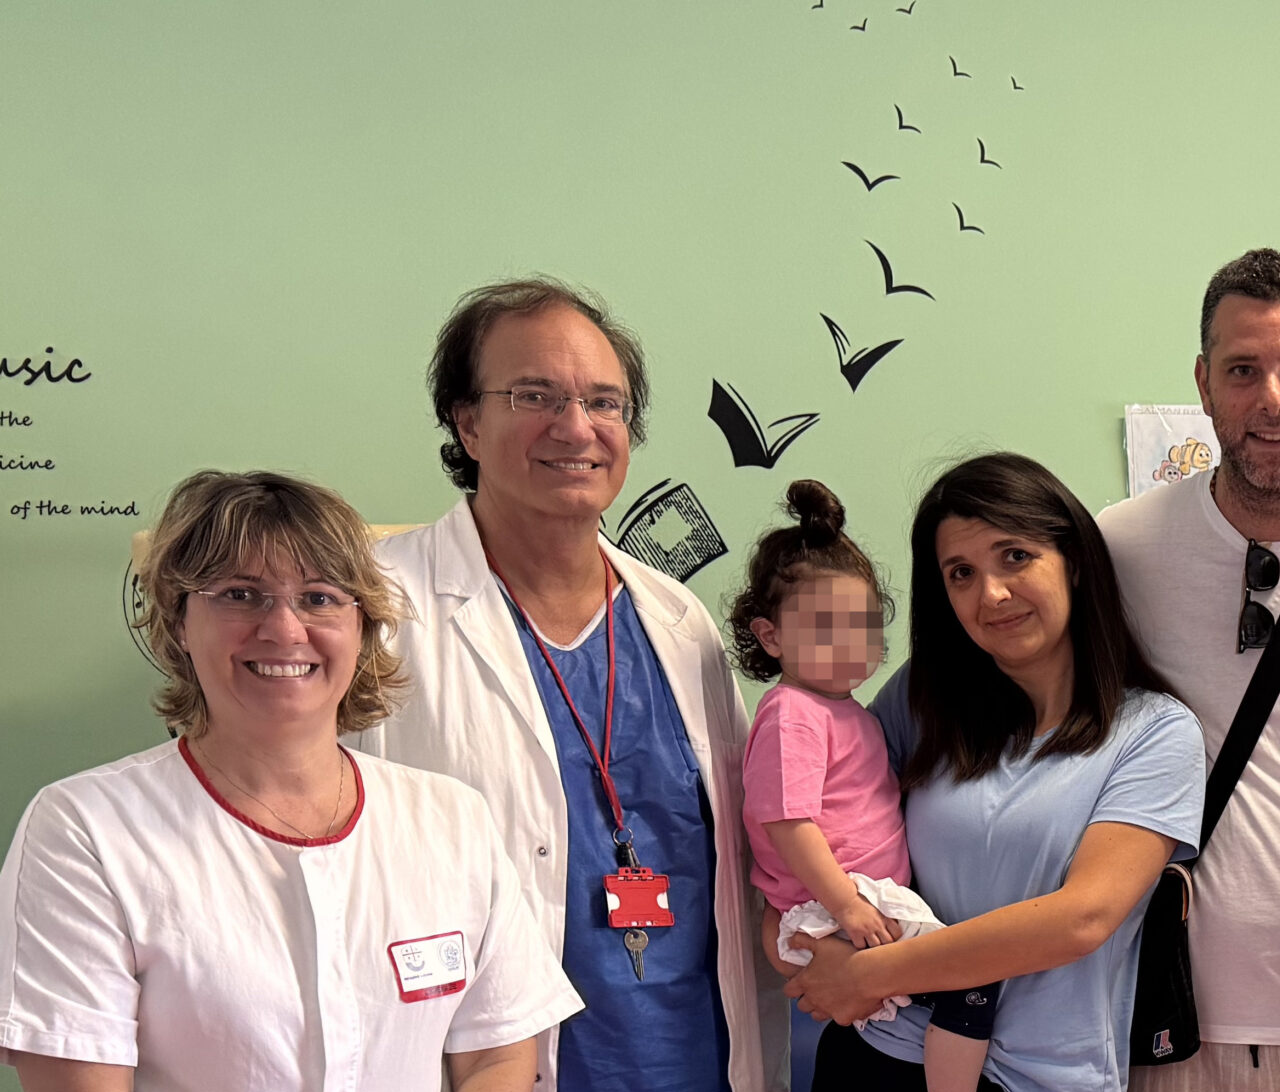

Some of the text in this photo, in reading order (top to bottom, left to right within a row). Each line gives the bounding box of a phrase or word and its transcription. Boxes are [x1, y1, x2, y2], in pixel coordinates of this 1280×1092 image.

[0, 411, 32, 427] the
[11, 500, 139, 520] of the mind
